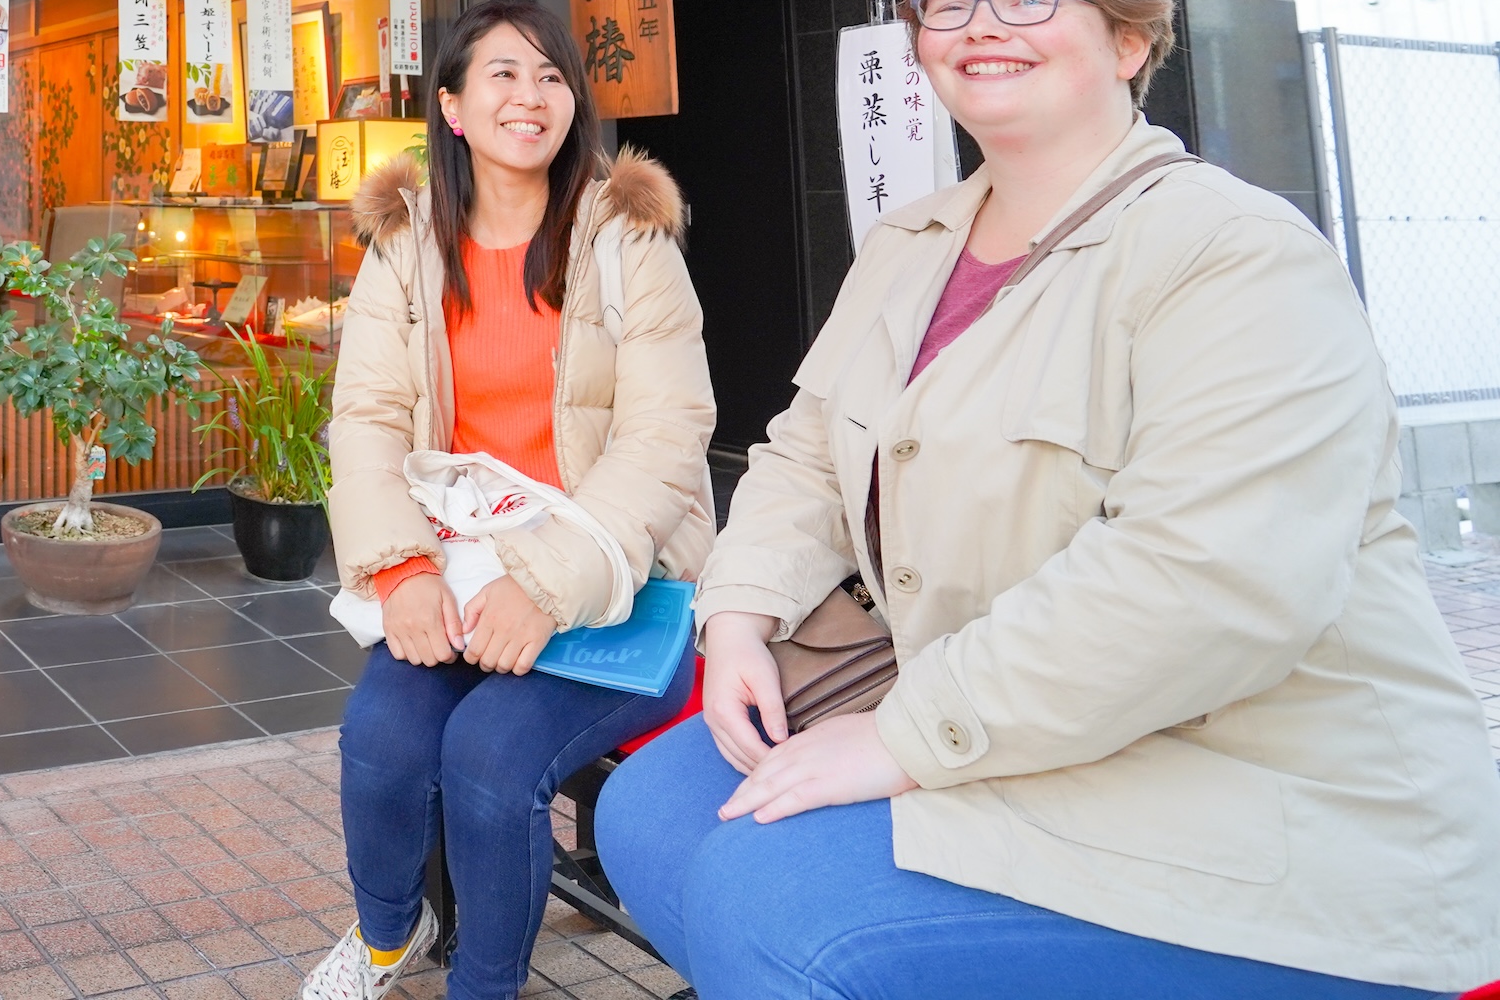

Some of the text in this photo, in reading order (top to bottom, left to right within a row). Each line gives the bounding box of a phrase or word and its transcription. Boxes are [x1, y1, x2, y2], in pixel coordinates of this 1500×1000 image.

[858, 50, 889, 215] 栗蒸し羊
[557, 640, 642, 665] Tour
